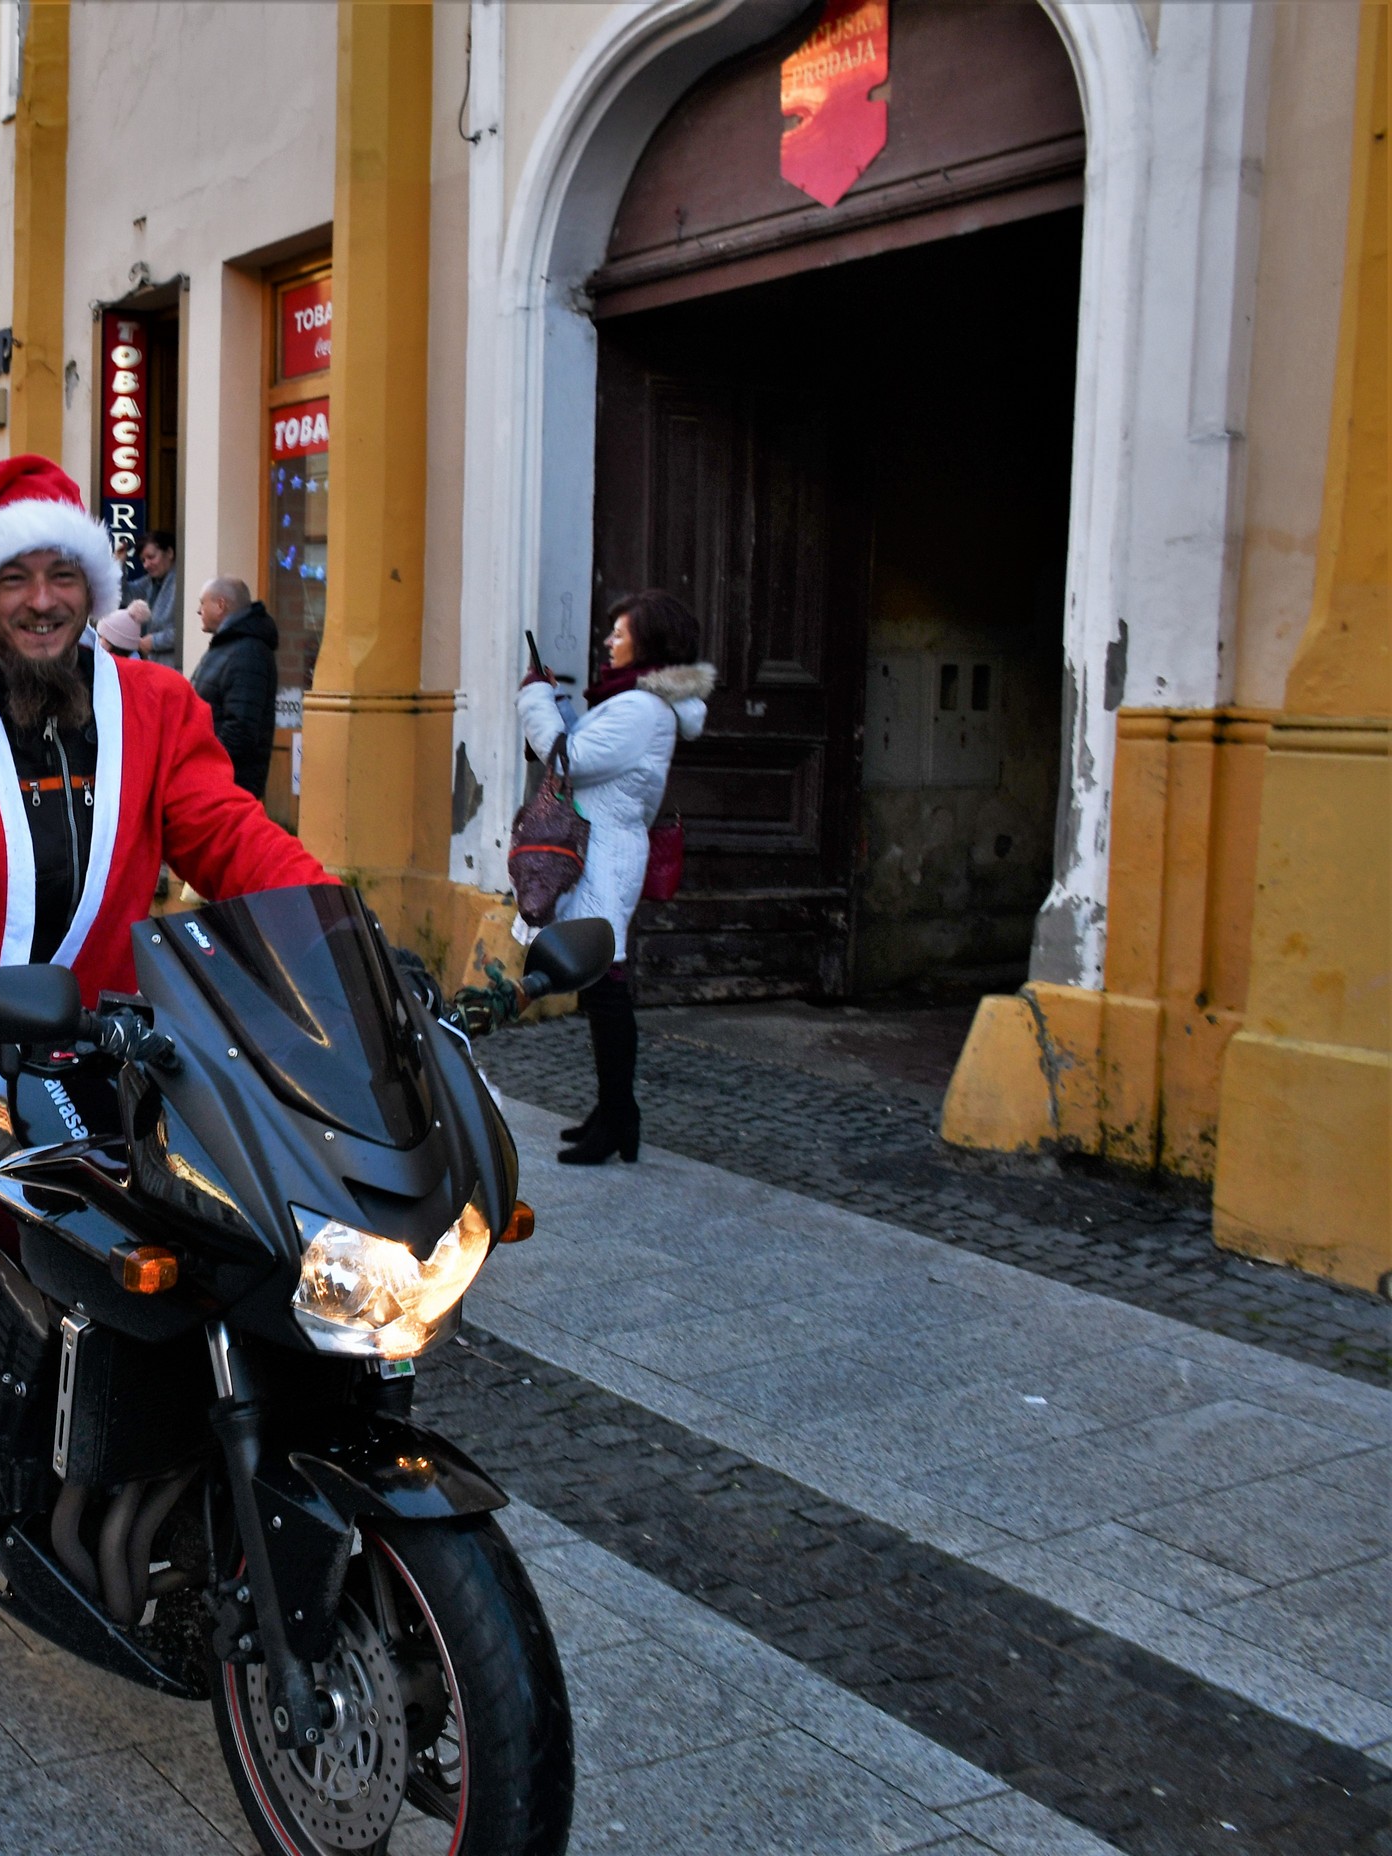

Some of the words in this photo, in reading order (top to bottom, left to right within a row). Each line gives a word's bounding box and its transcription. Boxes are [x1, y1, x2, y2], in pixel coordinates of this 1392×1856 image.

[792, 37, 876, 90] PRODAJA
[109, 321, 143, 495] TOBACCO
[184, 921, 211, 949] Puig
[42, 1078, 96, 1141] awasa
